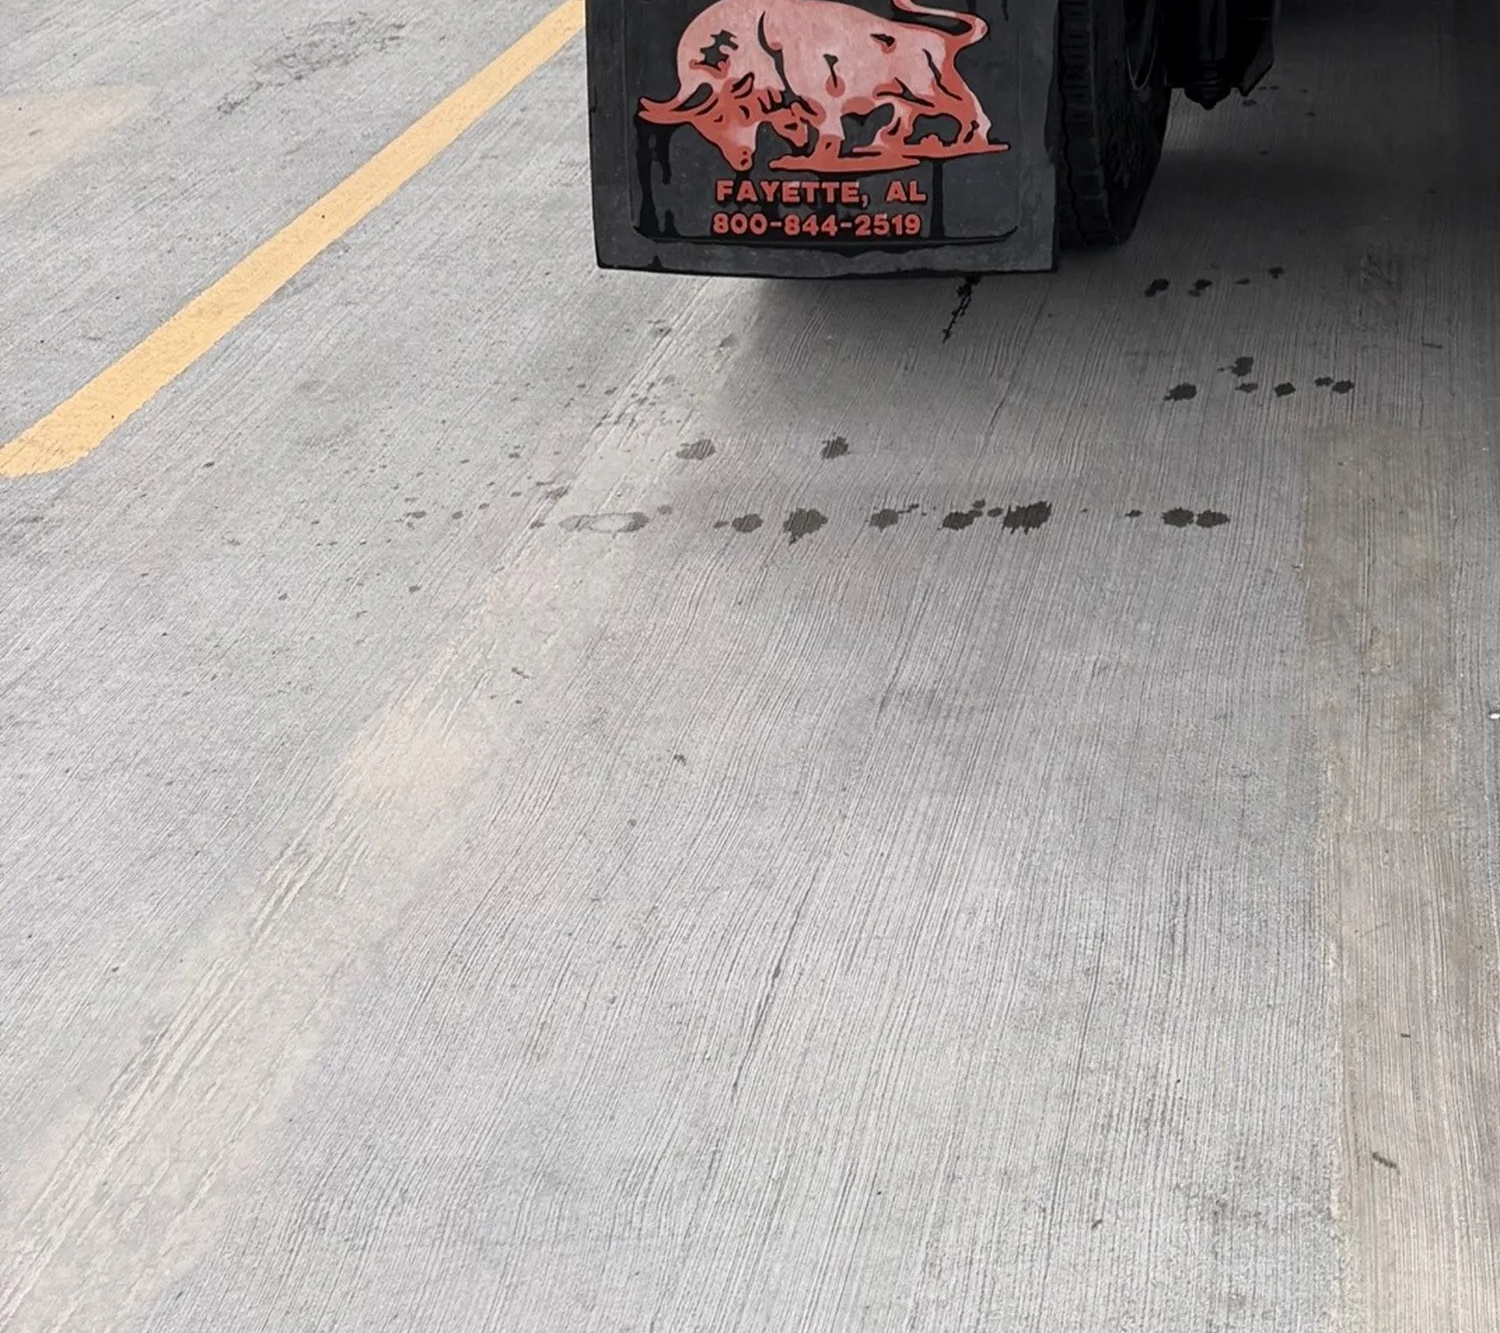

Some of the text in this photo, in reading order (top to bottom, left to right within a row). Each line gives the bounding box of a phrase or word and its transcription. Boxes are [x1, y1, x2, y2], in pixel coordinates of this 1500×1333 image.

[715, 180, 927, 206] FAYETTE, AL
[712, 213, 921, 236] 800-844-2519
